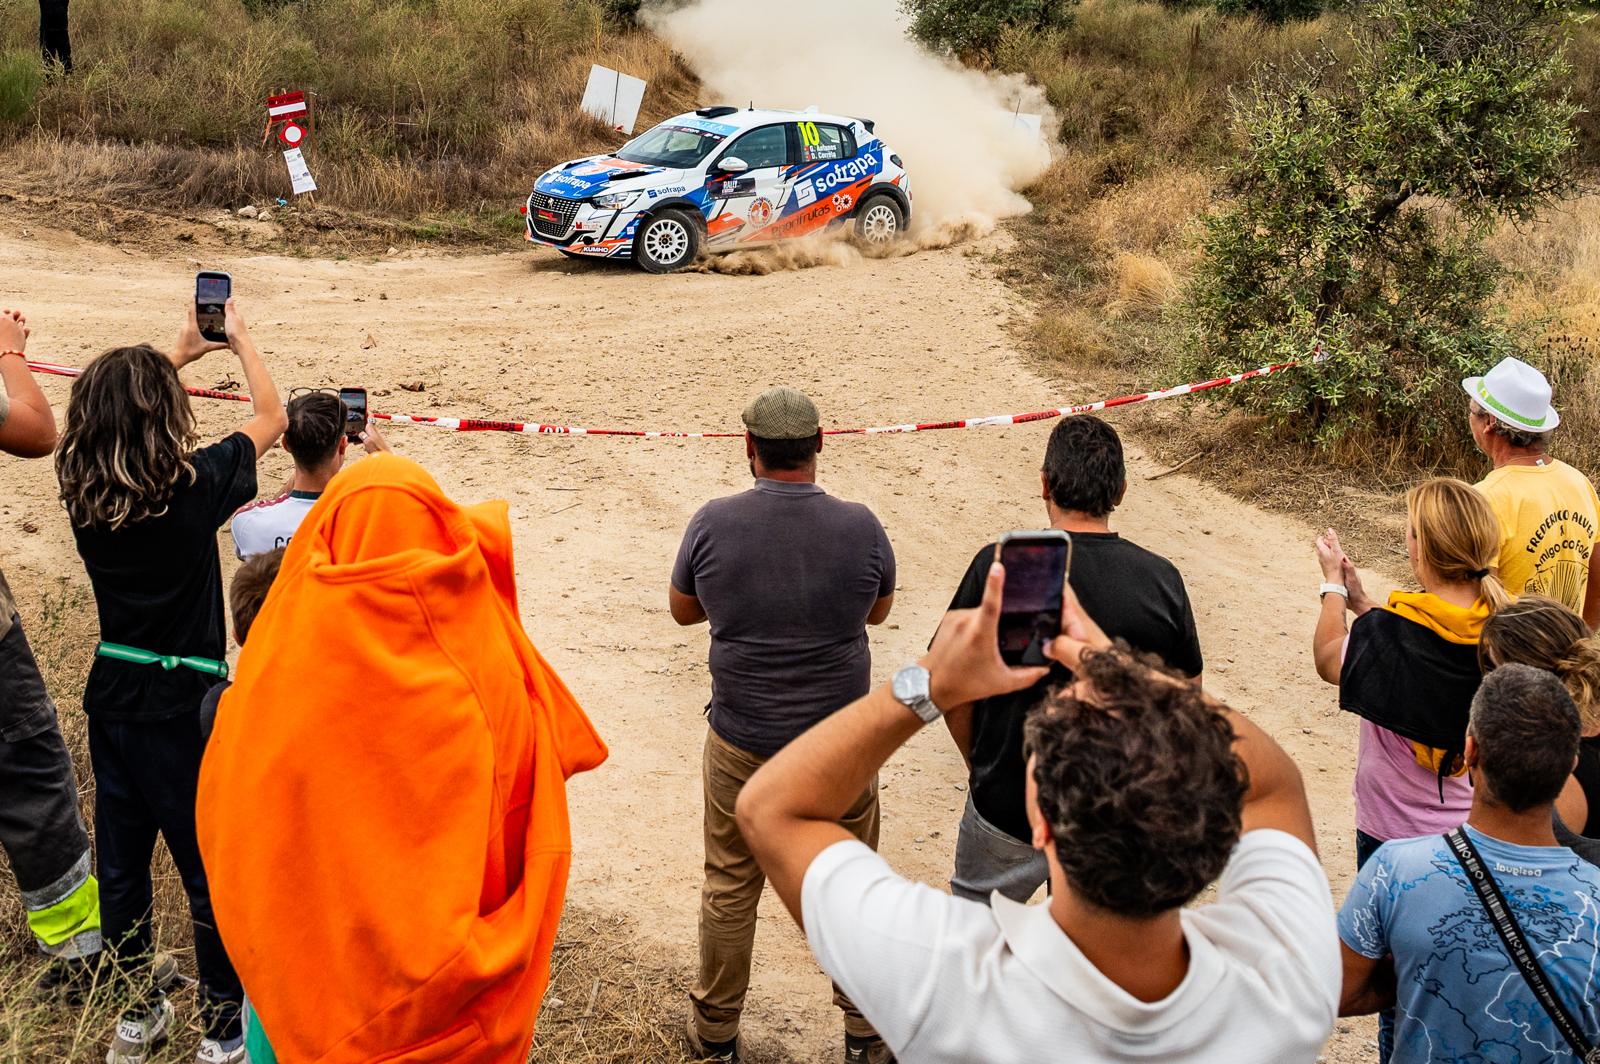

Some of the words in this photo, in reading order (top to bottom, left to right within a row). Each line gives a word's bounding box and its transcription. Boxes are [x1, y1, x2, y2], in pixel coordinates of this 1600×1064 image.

[798, 121, 820, 146] 10
[816, 153, 878, 193] sofrapa
[556, 174, 591, 190] sofrapa
[657, 186, 686, 195] sofrapa
[467, 419, 516, 431] DANGER
[1526, 509, 1569, 554] FREDERICO
[120, 1025, 143, 1040] FILA
